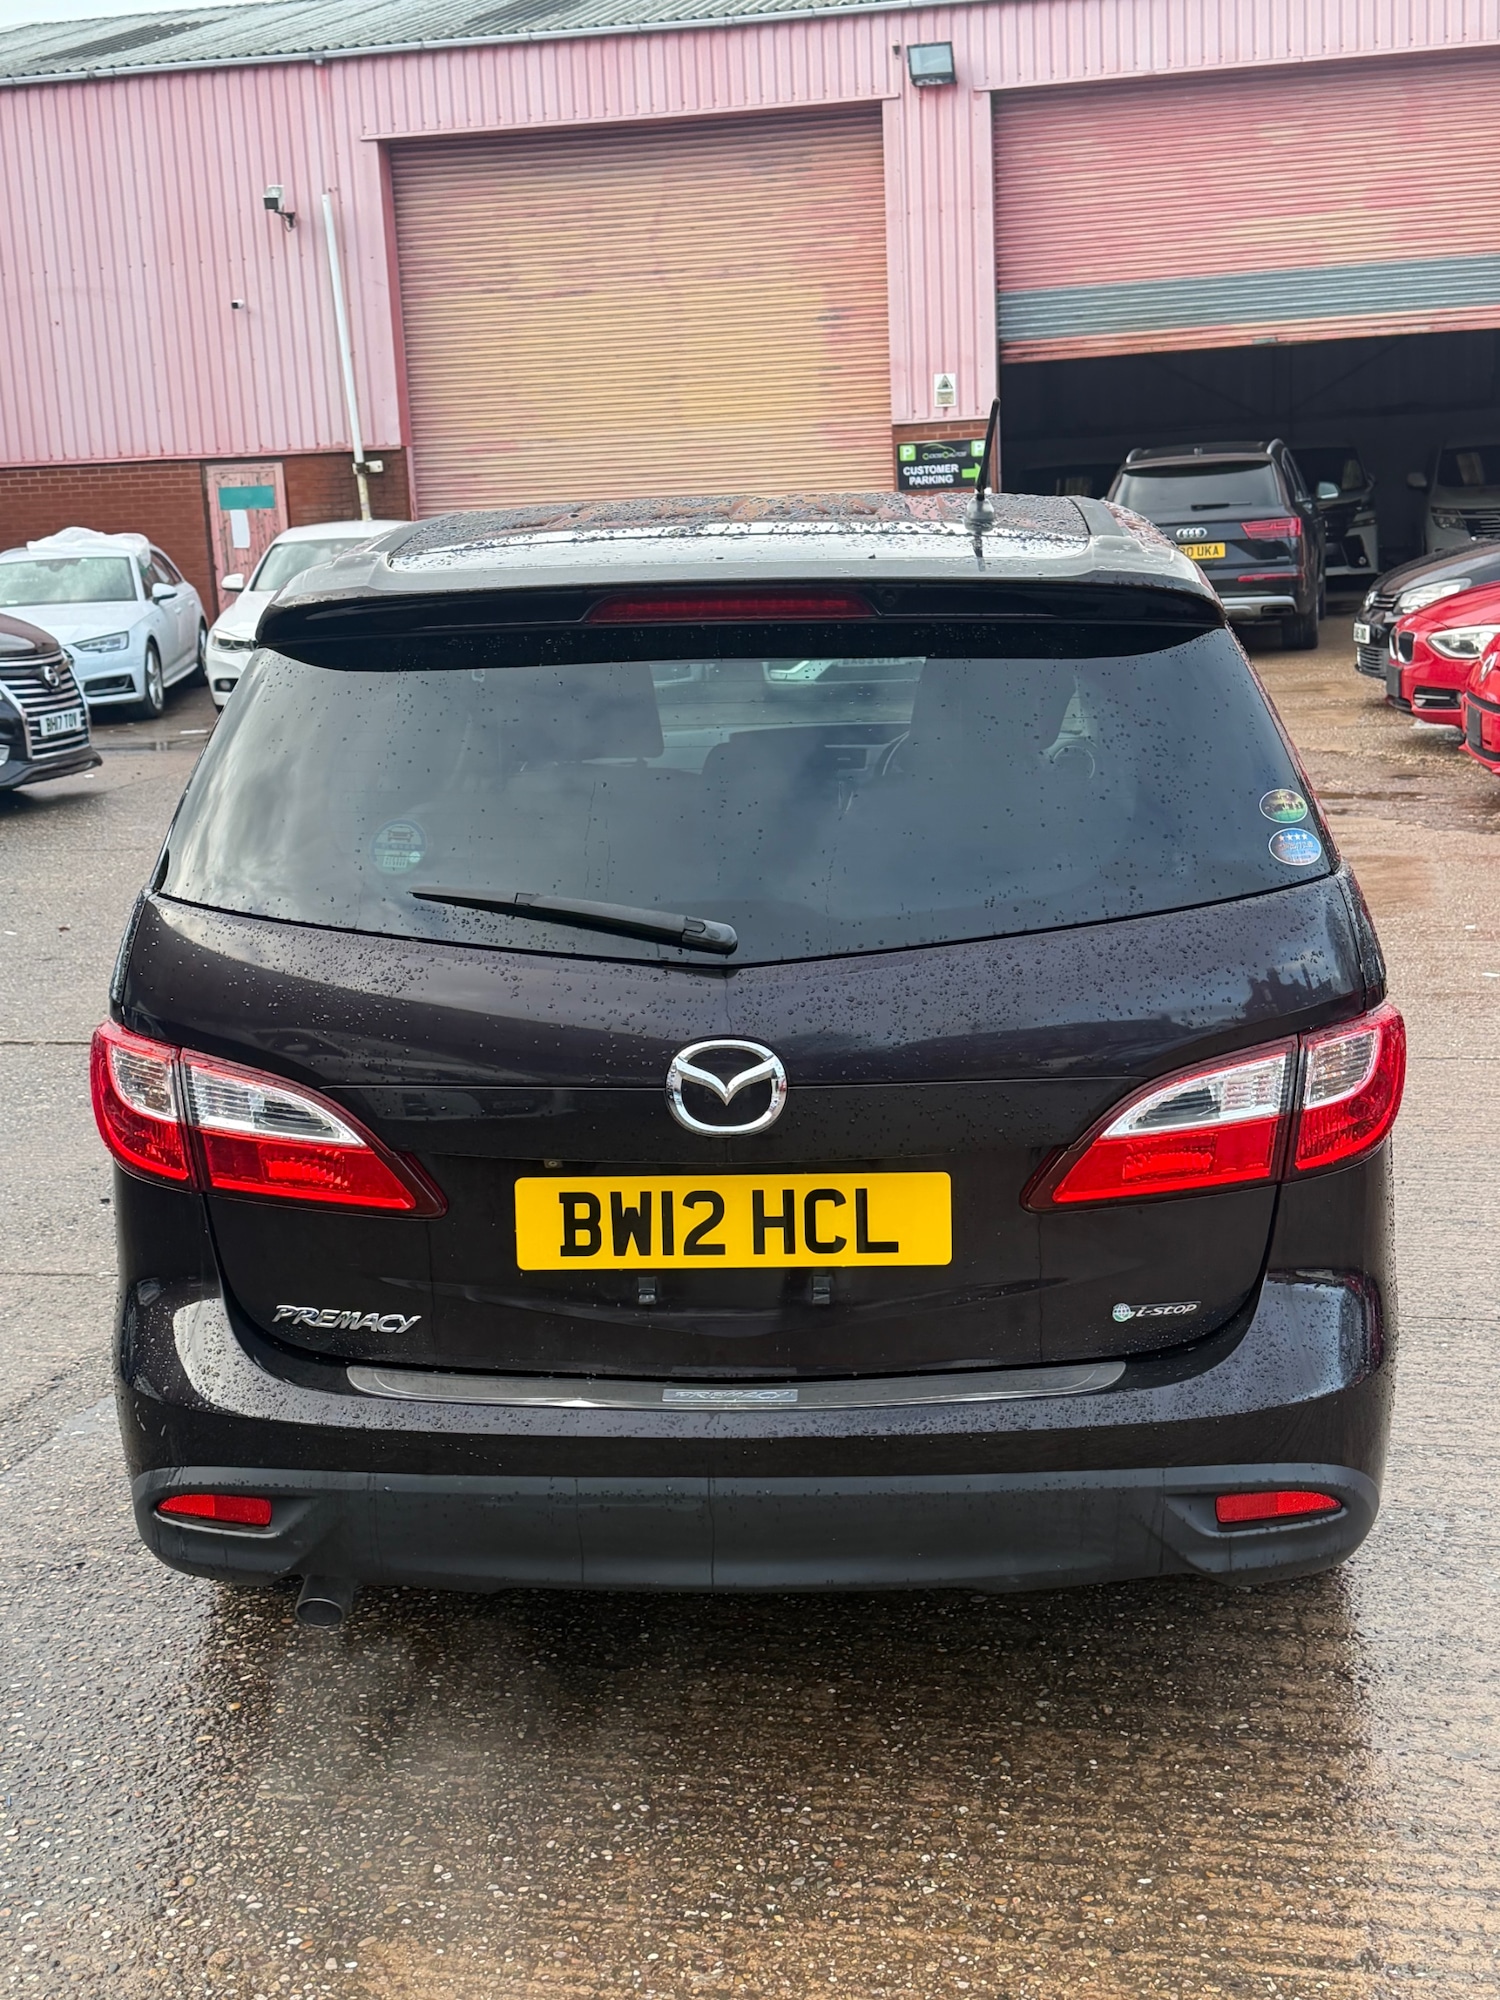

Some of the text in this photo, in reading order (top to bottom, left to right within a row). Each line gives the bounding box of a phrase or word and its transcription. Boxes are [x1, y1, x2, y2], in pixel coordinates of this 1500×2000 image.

[902, 464, 959, 476] CUSTOMER
[909, 475, 954, 486] PARKING
[1197, 545, 1219, 557] UKA
[558, 1188, 899, 1257] BW12 HCL
[272, 1304, 422, 1334] PREMACY
